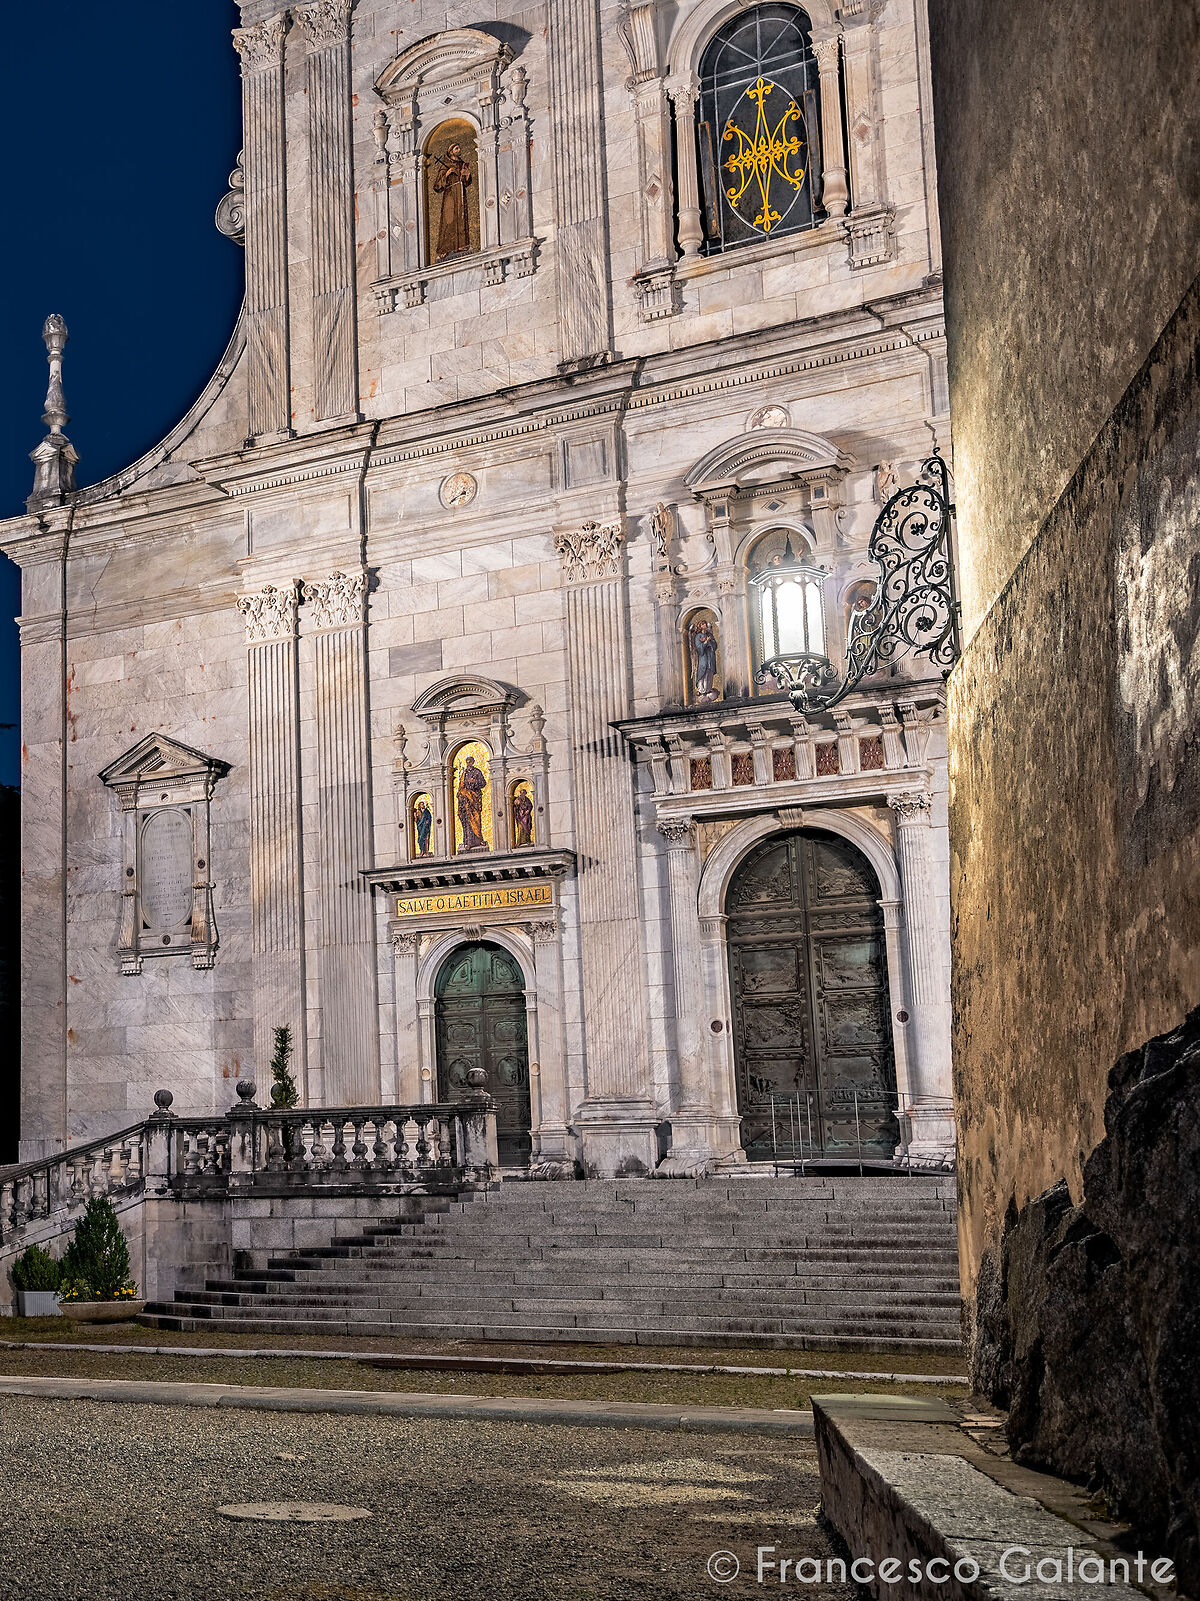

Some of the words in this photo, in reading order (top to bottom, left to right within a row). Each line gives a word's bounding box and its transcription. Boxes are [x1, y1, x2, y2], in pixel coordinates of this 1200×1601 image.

[399, 899, 433, 914] SALVE
[436, 898, 445, 910] O
[448, 894, 502, 909] LAETITIA
[506, 889, 549, 904] ISRAEL
